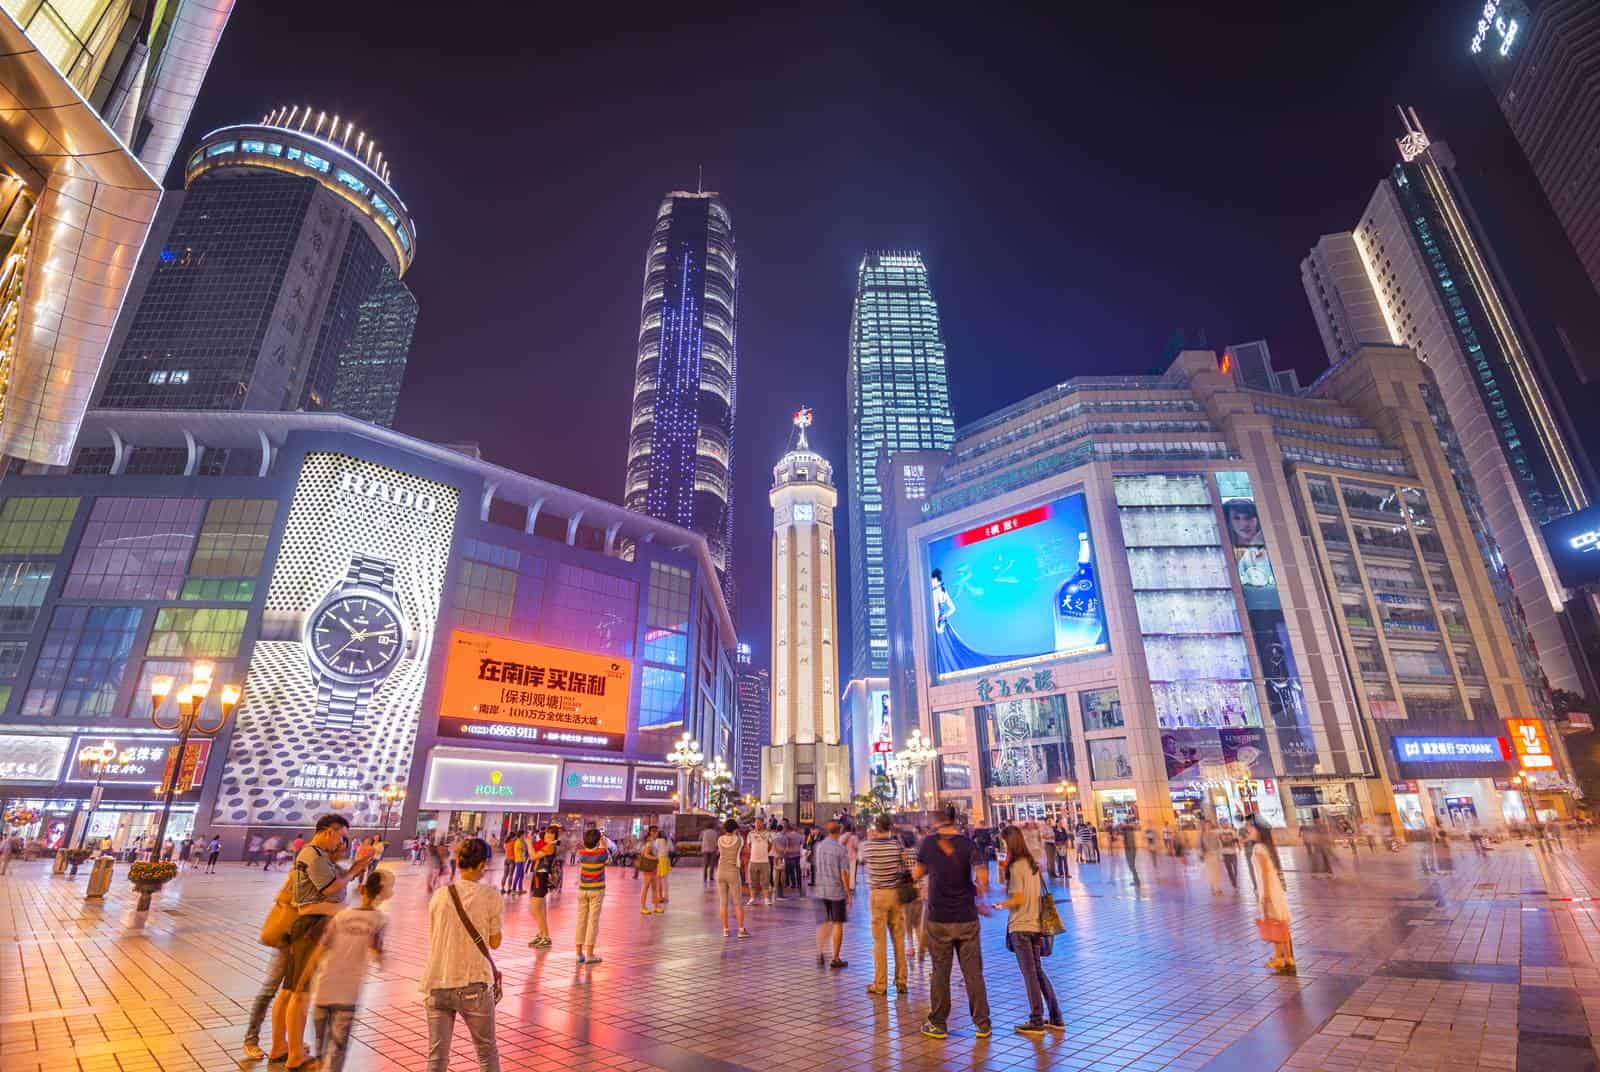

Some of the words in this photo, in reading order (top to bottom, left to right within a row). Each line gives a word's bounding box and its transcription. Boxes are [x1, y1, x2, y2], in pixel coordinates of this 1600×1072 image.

[341, 472, 436, 513] RADO
[478, 658, 545, 687] 在南岸
[547, 667, 606, 697] 买保利
[475, 785, 513, 795] ROLEX
